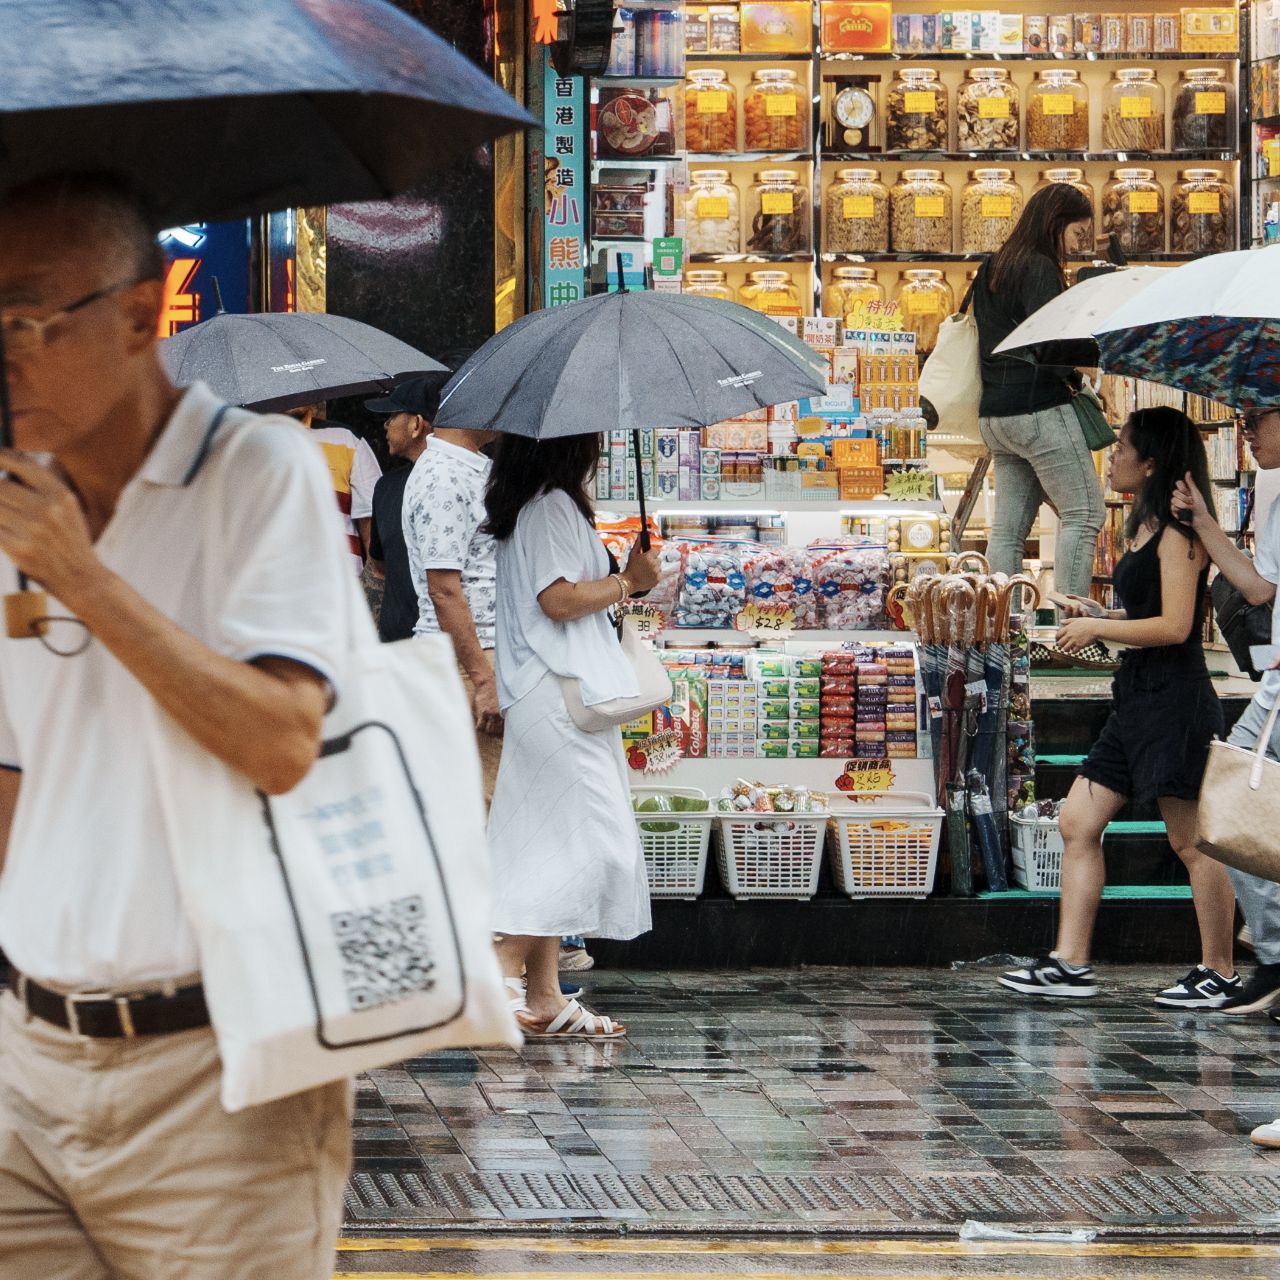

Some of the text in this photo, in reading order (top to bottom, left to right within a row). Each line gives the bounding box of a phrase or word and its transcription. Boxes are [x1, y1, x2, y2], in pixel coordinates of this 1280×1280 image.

[554, 76, 575, 188] 香港製造
[755, 617, 785, 631] $28
[689, 709, 703, 756] Colgate
